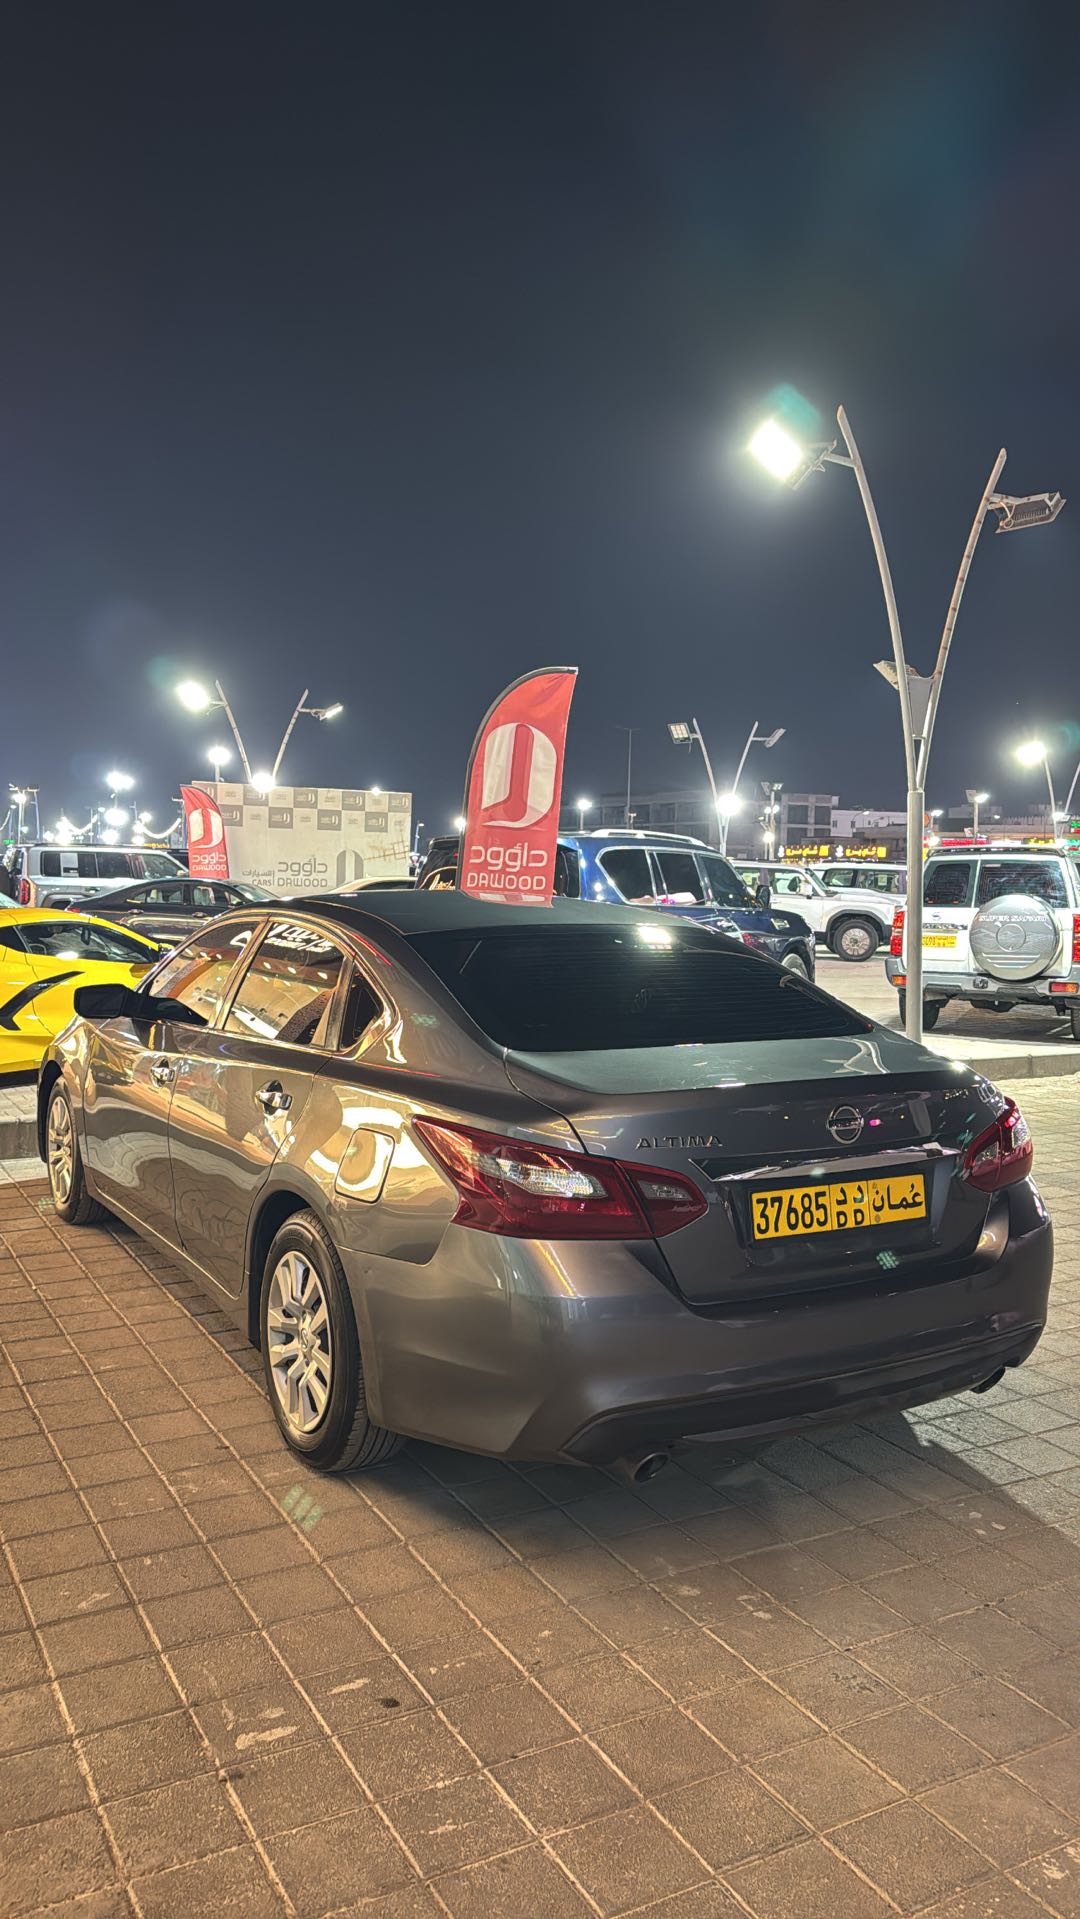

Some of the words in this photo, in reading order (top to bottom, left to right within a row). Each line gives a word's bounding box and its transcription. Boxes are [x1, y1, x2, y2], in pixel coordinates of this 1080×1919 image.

[252, 879, 272, 887] CARS
[277, 877, 328, 888] DAWOOD
[466, 872, 546, 891] DAWOOD
[636, 1135, 723, 1150] ALTIMA
[755, 1190, 828, 1235] 37685
